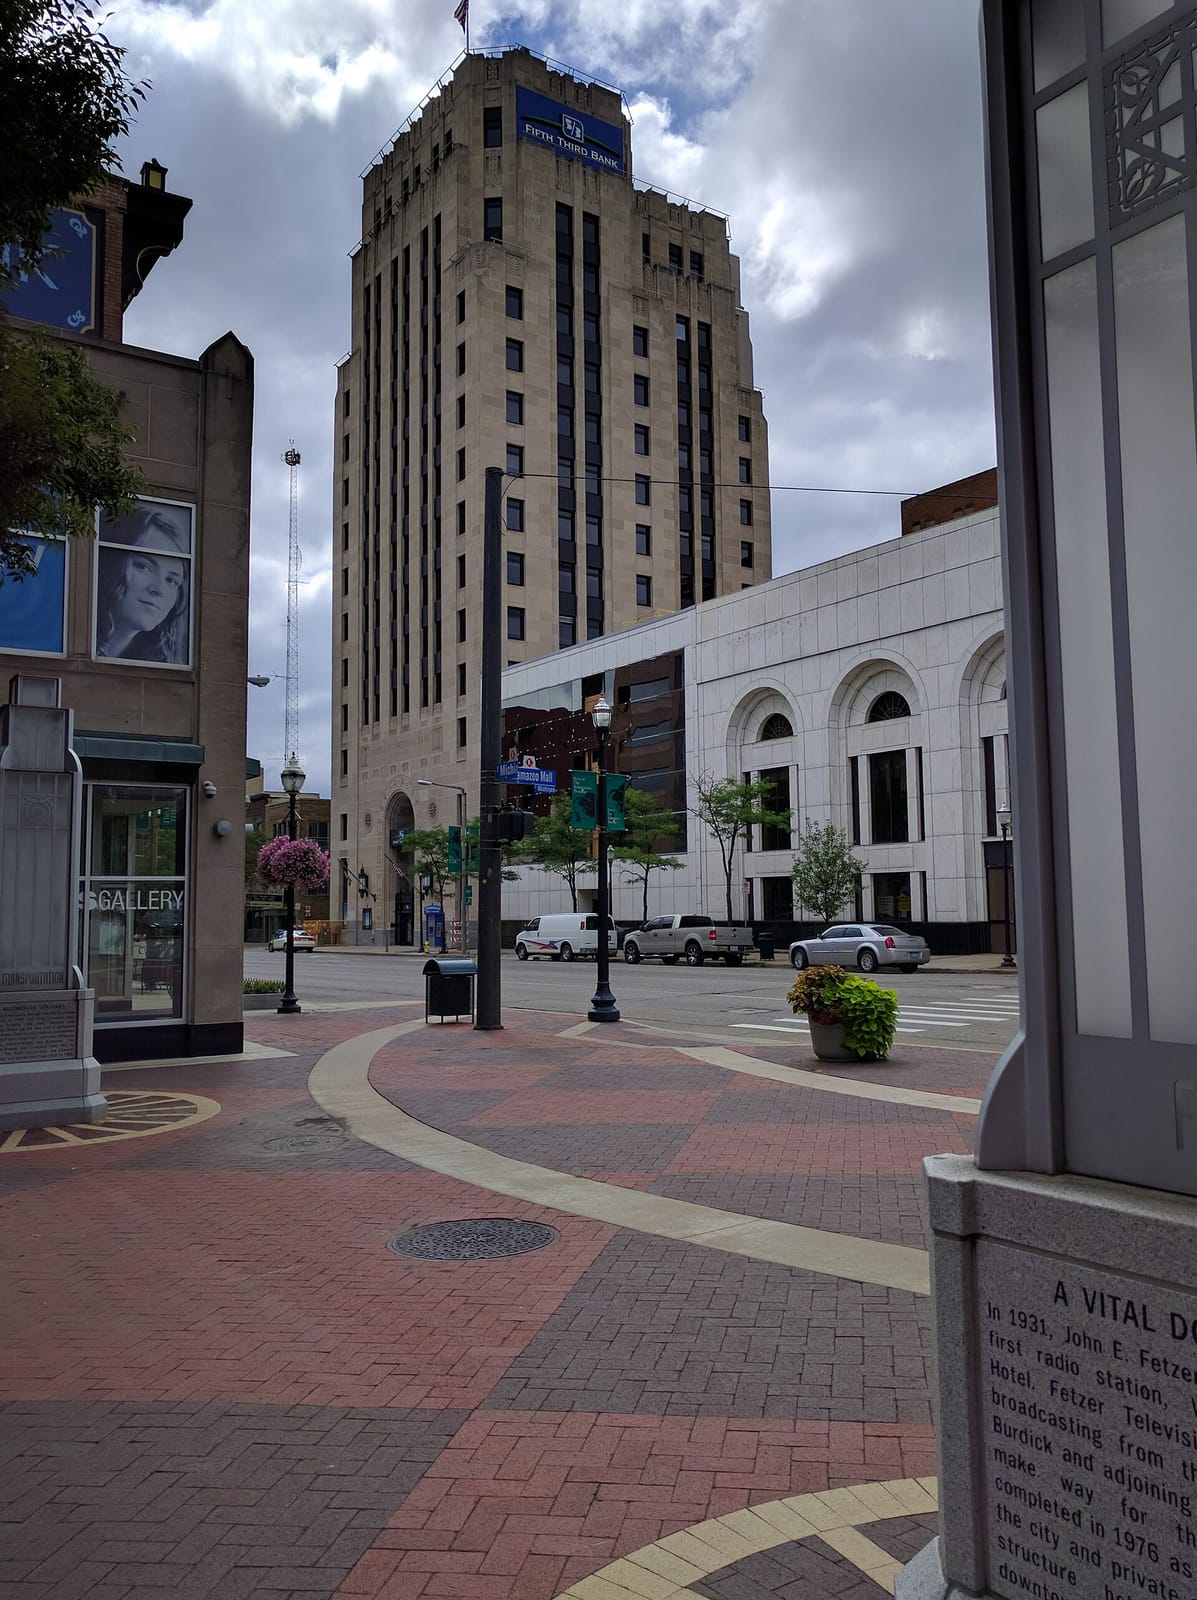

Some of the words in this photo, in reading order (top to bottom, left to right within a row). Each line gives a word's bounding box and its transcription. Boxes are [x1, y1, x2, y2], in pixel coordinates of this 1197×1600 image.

[525, 123, 553, 142] FIFTH
[557, 136, 588, 156] THIRD
[591, 150, 618, 168] BANK
[540, 770, 553, 783] Mall
[987, 1302, 1000, 1321] In
[1009, 1308, 1053, 1341] 1931,
[1065, 1326, 1102, 1354] John
[1113, 1340, 1129, 1363] E.
[1053, 1280, 1069, 1307] A
[1082, 1287, 1156, 1333] VITAL
[989, 1330, 1022, 1357] first
[1037, 1349, 1080, 1376] radio
[1096, 1370, 1168, 1411] station,
[990, 1358, 1036, 1390] Hotel.
[1050, 1379, 1104, 1415] Fetzer
[991, 1387, 1103, 1449] broadcasting
[1119, 1435, 1164, 1469] from
[993, 1415, 1053, 1455] Burdick
[1062, 1448, 1094, 1472] and
[1103, 1465, 1192, 1518] adjoining
[995, 1476, 1082, 1528] completed
[1090, 1515, 1105, 1538] in
[1113, 1526, 1159, 1563] 1976
[1170, 1556, 1193, 1579] as
[1060, 1476, 1094, 1506] way
[1120, 1498, 1148, 1525] for
[997, 1503, 1022, 1529] the
[1030, 1521, 1060, 1550] city
[1070, 1540, 1102, 1568] and
[1111, 1560, 1179, 1600] private
[998, 1535, 1077, 1586] structure
[999, 1562, 1064, 1600] downto
